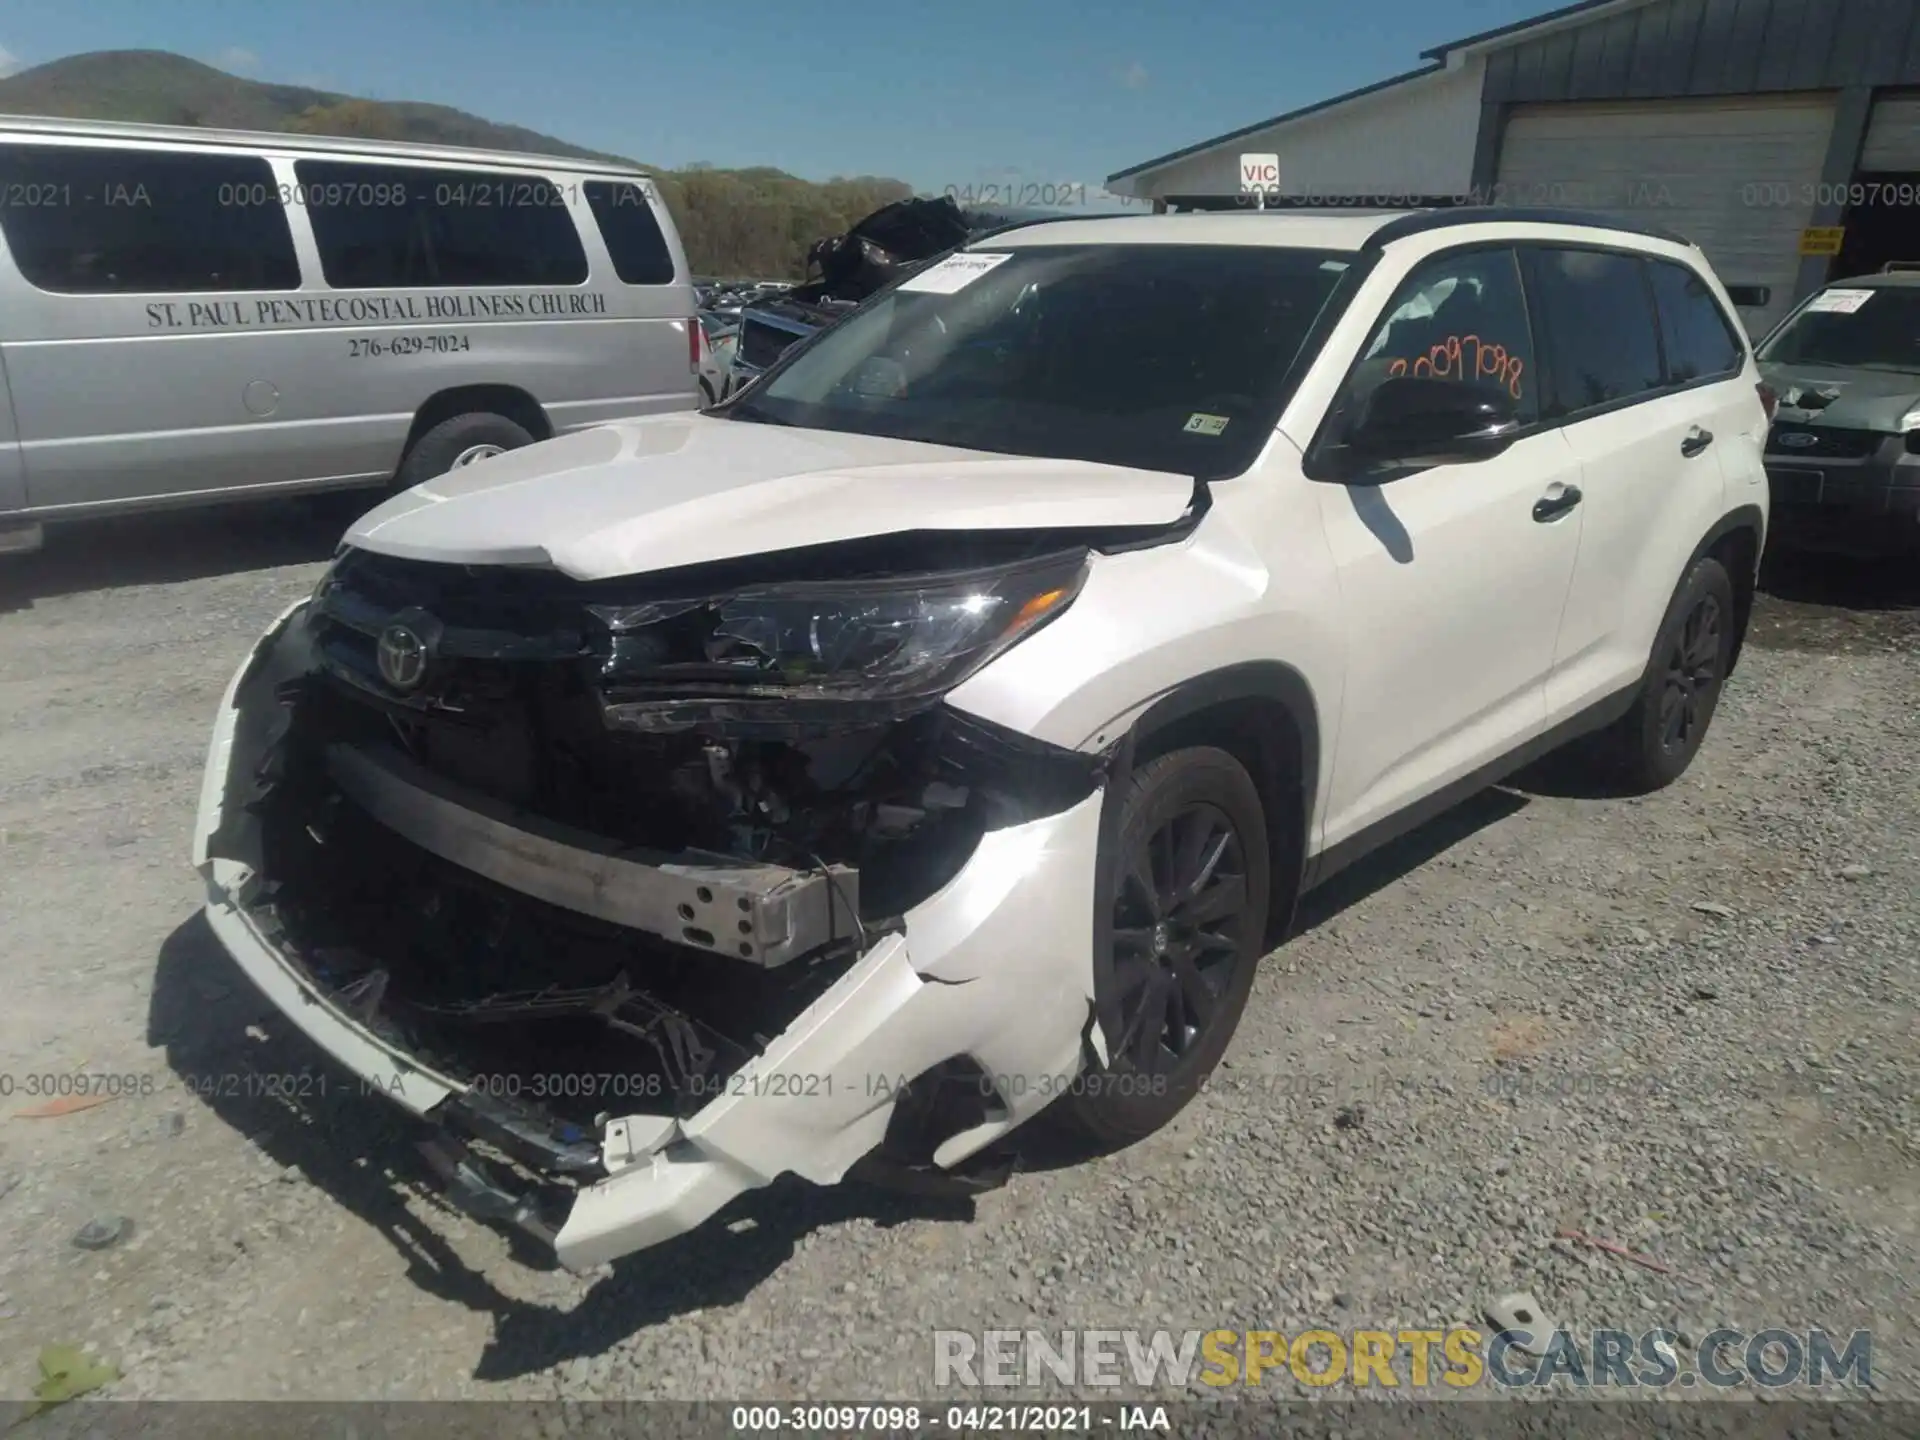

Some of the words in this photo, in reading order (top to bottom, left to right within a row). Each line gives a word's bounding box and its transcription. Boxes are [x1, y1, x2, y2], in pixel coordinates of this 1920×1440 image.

[1243, 164, 1277, 181] VIC
[146, 303, 182, 327] ST.
[190, 302, 249, 326] PAUL
[257, 297, 421, 323] PENTECOSTAL
[427, 294, 524, 317] HOLINESS
[528, 293, 606, 314] CHURCH
[349, 335, 470, 357] 276-629-7024
